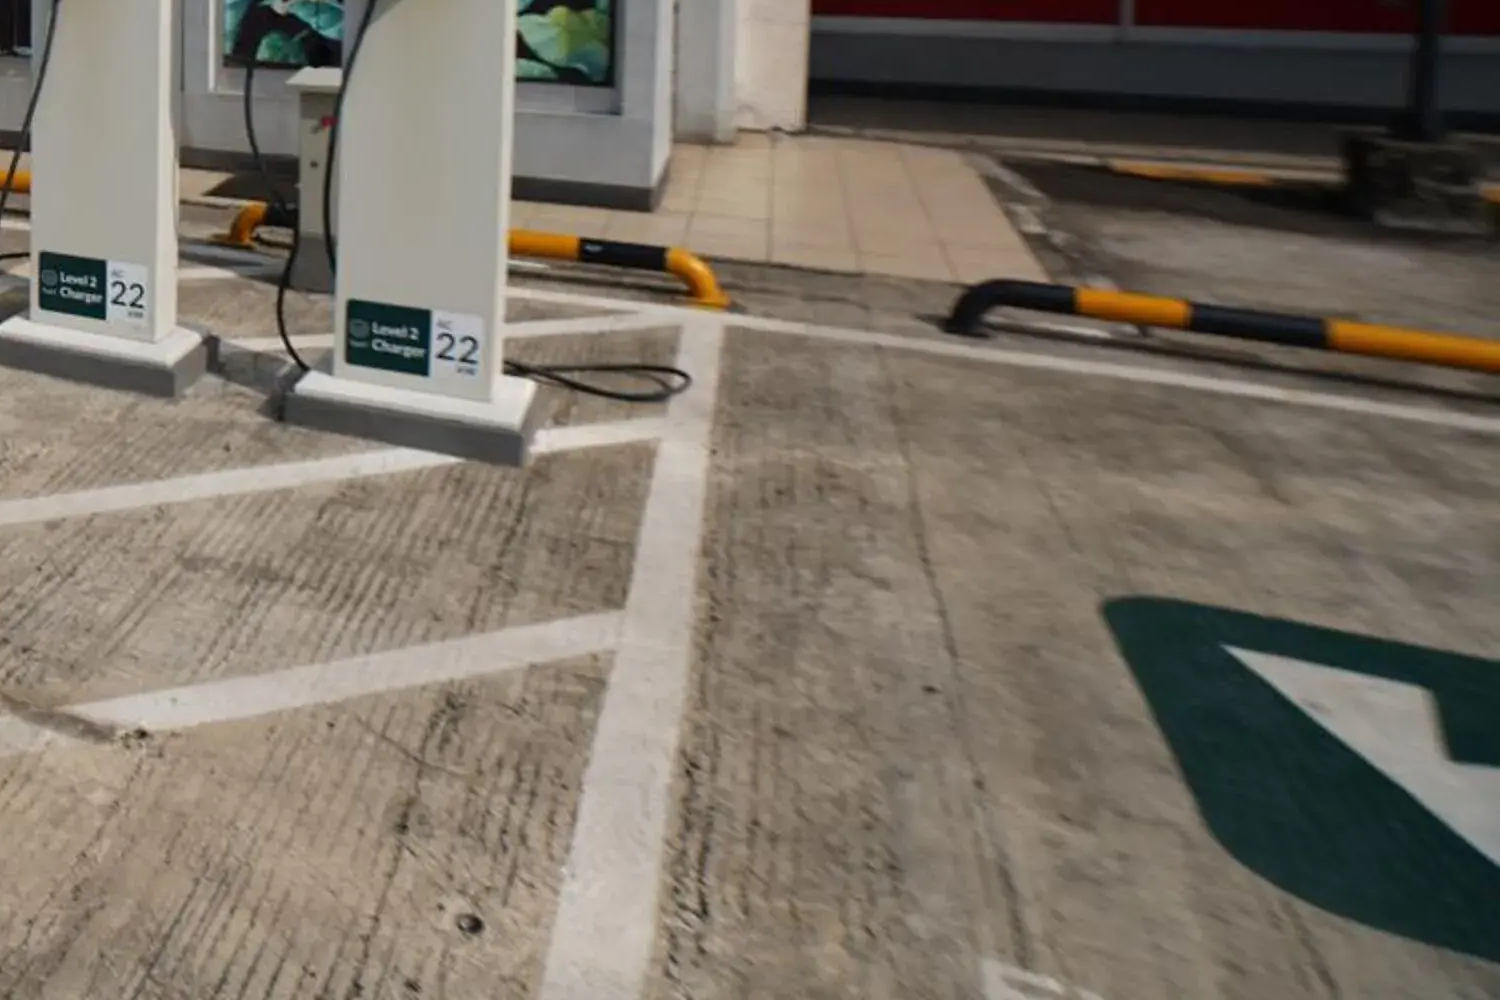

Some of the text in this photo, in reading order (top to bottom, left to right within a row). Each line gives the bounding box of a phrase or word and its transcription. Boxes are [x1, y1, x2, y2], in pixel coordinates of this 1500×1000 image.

[60, 272, 98, 288] Level 2
[59, 287, 104, 304] Charger
[110, 280, 145, 309] 22
[371, 321, 420, 341] Level 2
[371, 338, 427, 359] Charger
[434, 332, 480, 365] 22
